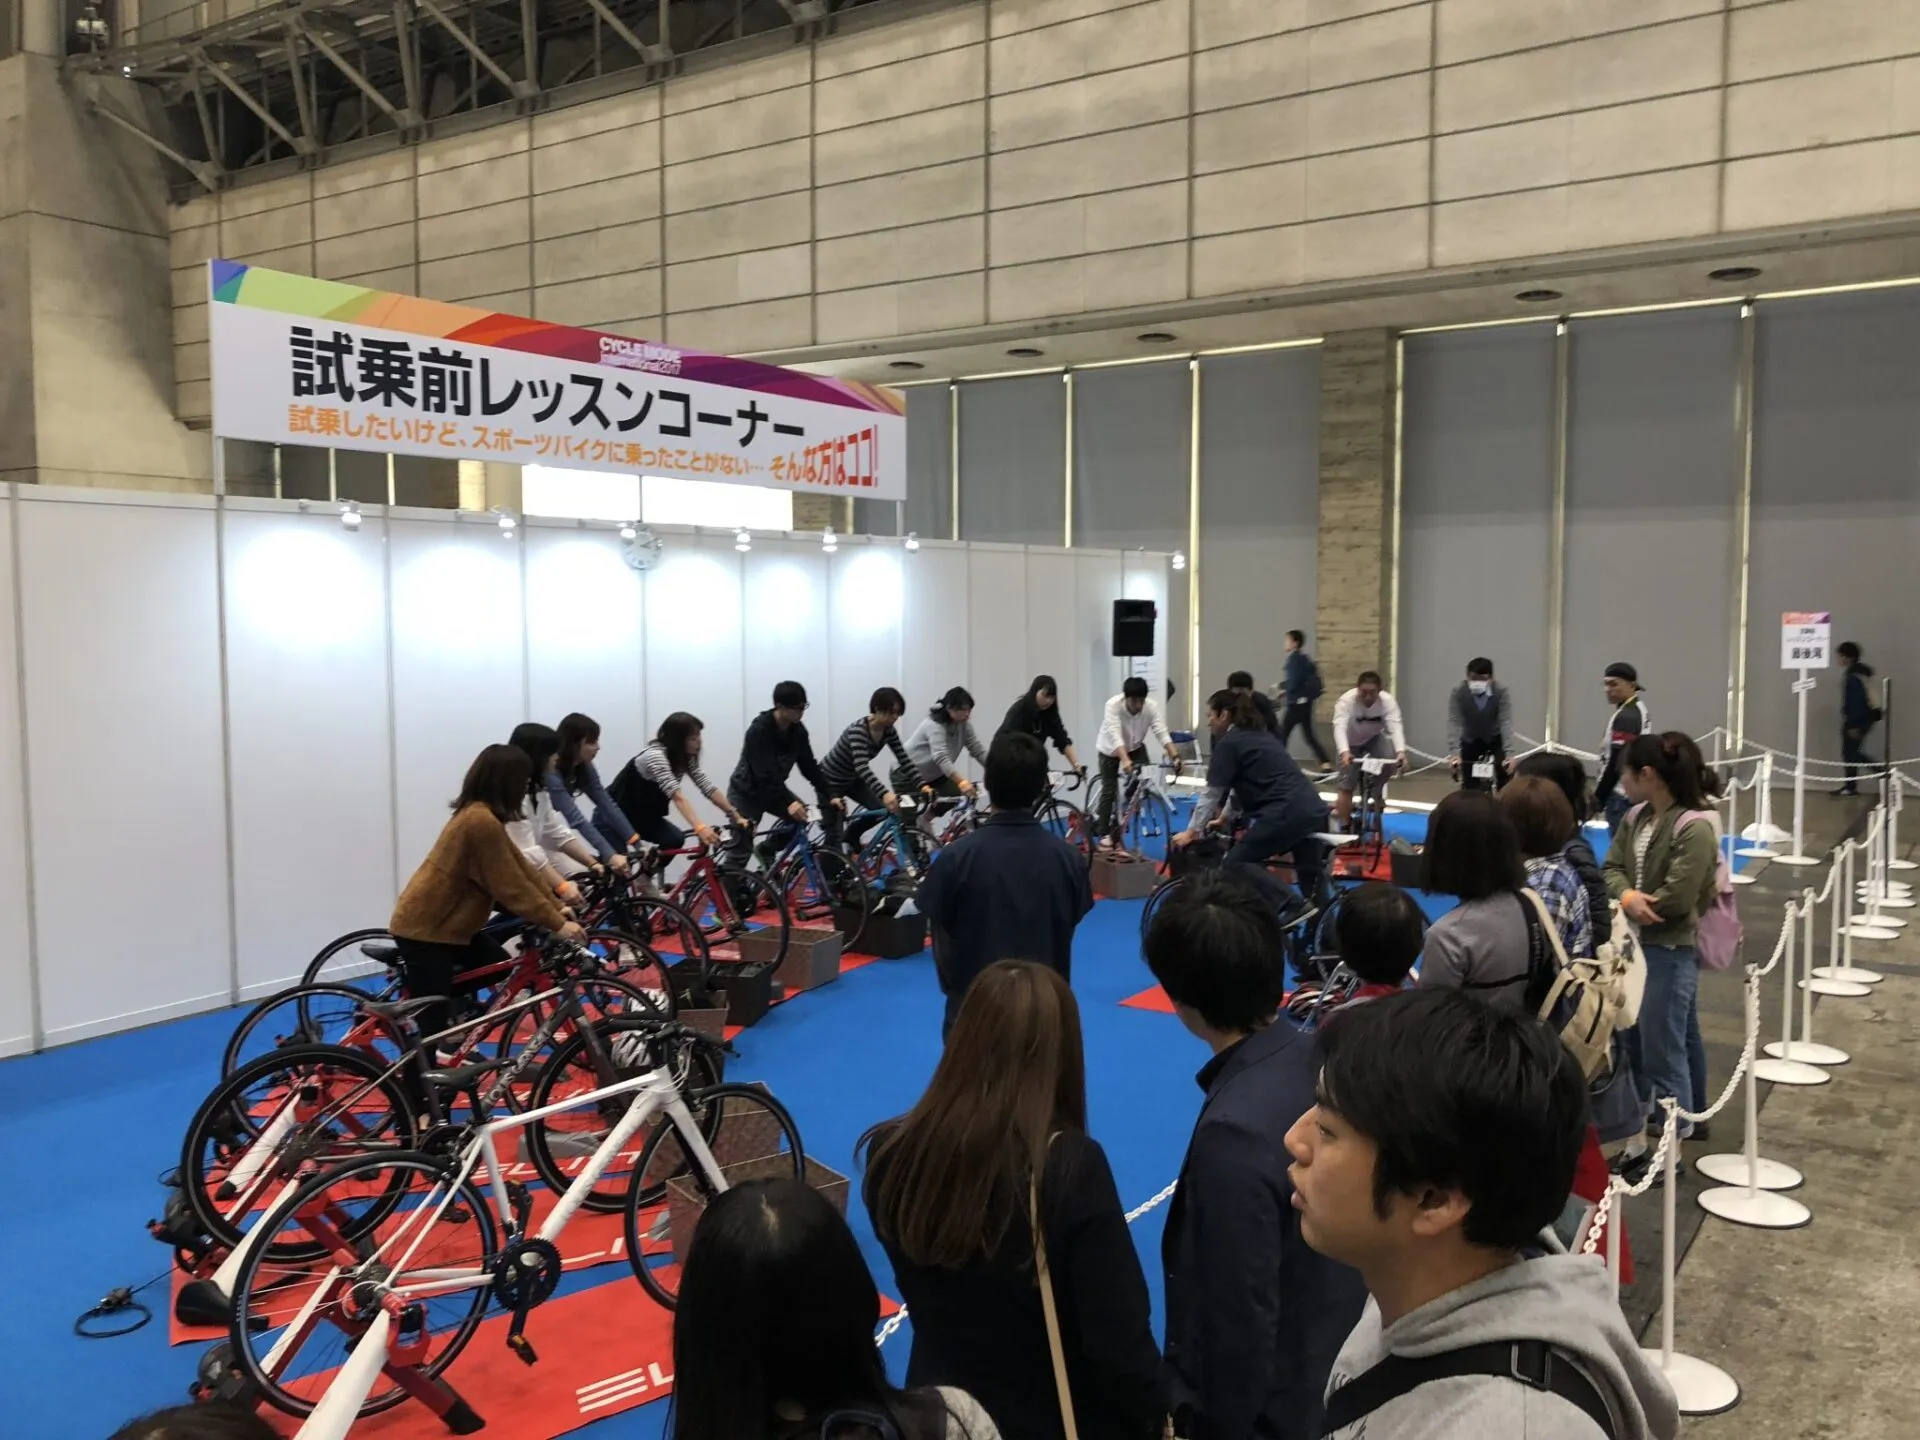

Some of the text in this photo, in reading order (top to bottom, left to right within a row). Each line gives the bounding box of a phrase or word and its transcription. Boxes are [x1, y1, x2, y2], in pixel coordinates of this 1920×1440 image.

[289, 325, 805, 448] 試乗前レッスンコーナー
